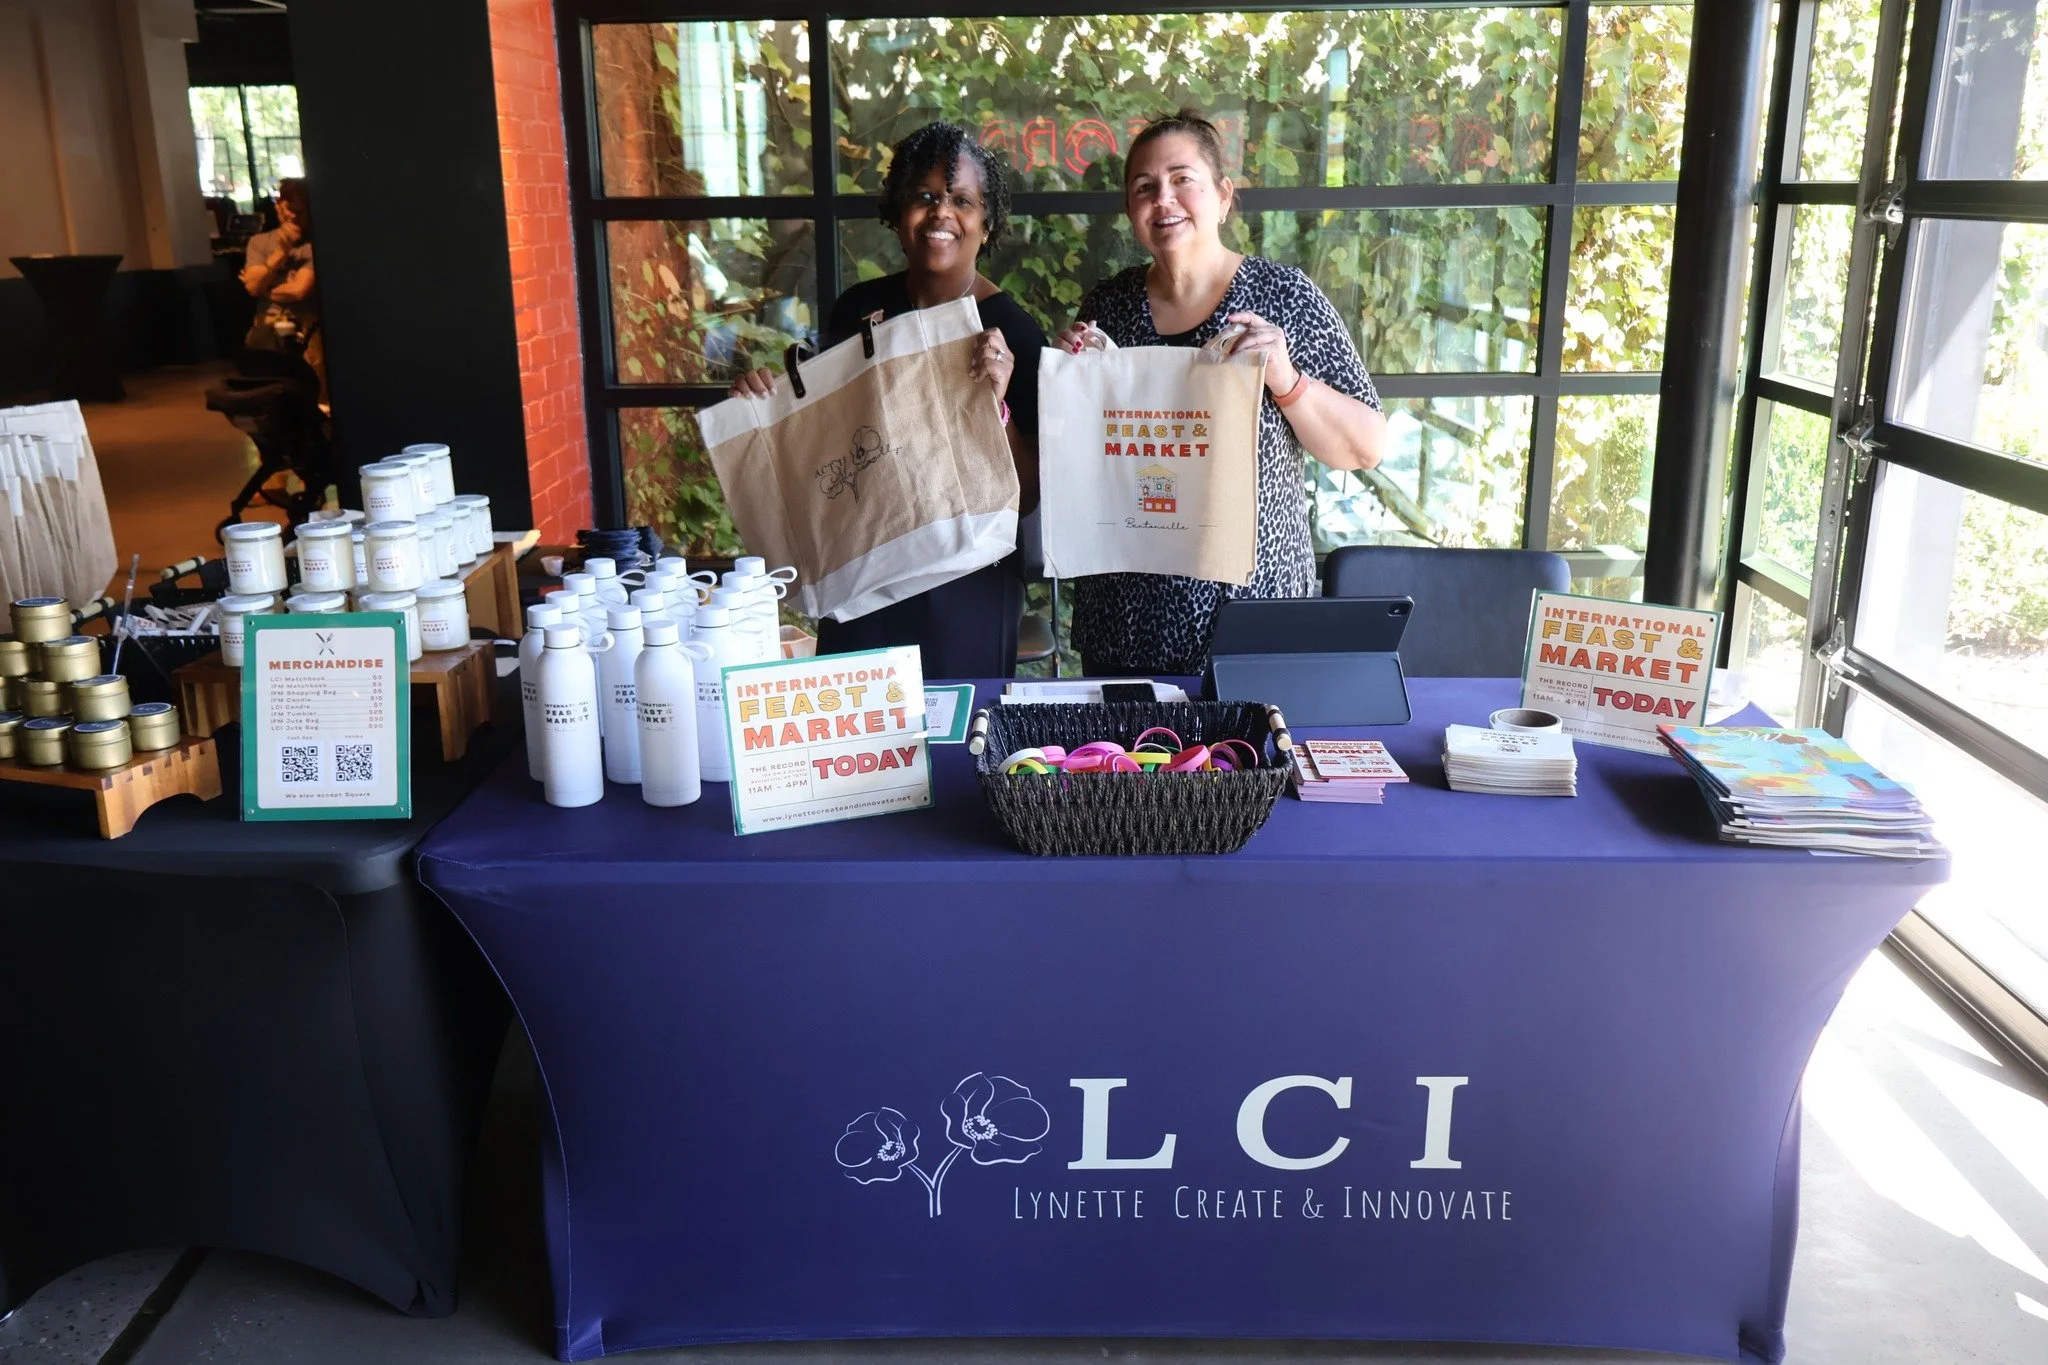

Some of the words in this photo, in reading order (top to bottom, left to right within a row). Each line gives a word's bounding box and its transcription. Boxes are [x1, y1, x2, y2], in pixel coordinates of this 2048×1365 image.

[1103, 410, 1211, 420] INTERNATIONAL
[1107, 424, 1186, 438] FEAST
[1192, 423, 1208, 437] &
[1105, 443, 1210, 458] MARKET
[1124, 516, 1189, 531] Bentonville
[1544, 606, 1707, 638] INTERNATIONAL
[1542, 619, 1662, 653] FEAST
[1676, 637, 1703, 660] &
[269, 659, 384, 671] MERCHANDISE
[1539, 643, 1699, 684] MARKET
[737, 666, 897, 698] INTERNATIONA
[1539, 677, 1554, 685] THE
[1556, 680, 1589, 689] RECORD
[739, 685, 867, 722] FEAST
[1532, 693, 1554, 703] 11AM
[1593, 686, 1696, 720] TODAY
[743, 707, 907, 751] MARKET
[750, 766, 767, 774] THE
[770, 760, 806, 770] RECORD
[812, 745, 918, 780] TODAY
[345, 791, 371, 799] Square
[748, 785, 773, 794] 11AM
[785, 779, 808, 788] 4PM
[762, 794, 912, 824] www.lynettecreateandinnovate.net
[1013, 1185, 1145, 1221] LYNETTE
[1174, 1185, 1283, 1220] CREATE
[1301, 1187, 1325, 1220] &
[1343, 1186, 1513, 1223] INNOVATE
